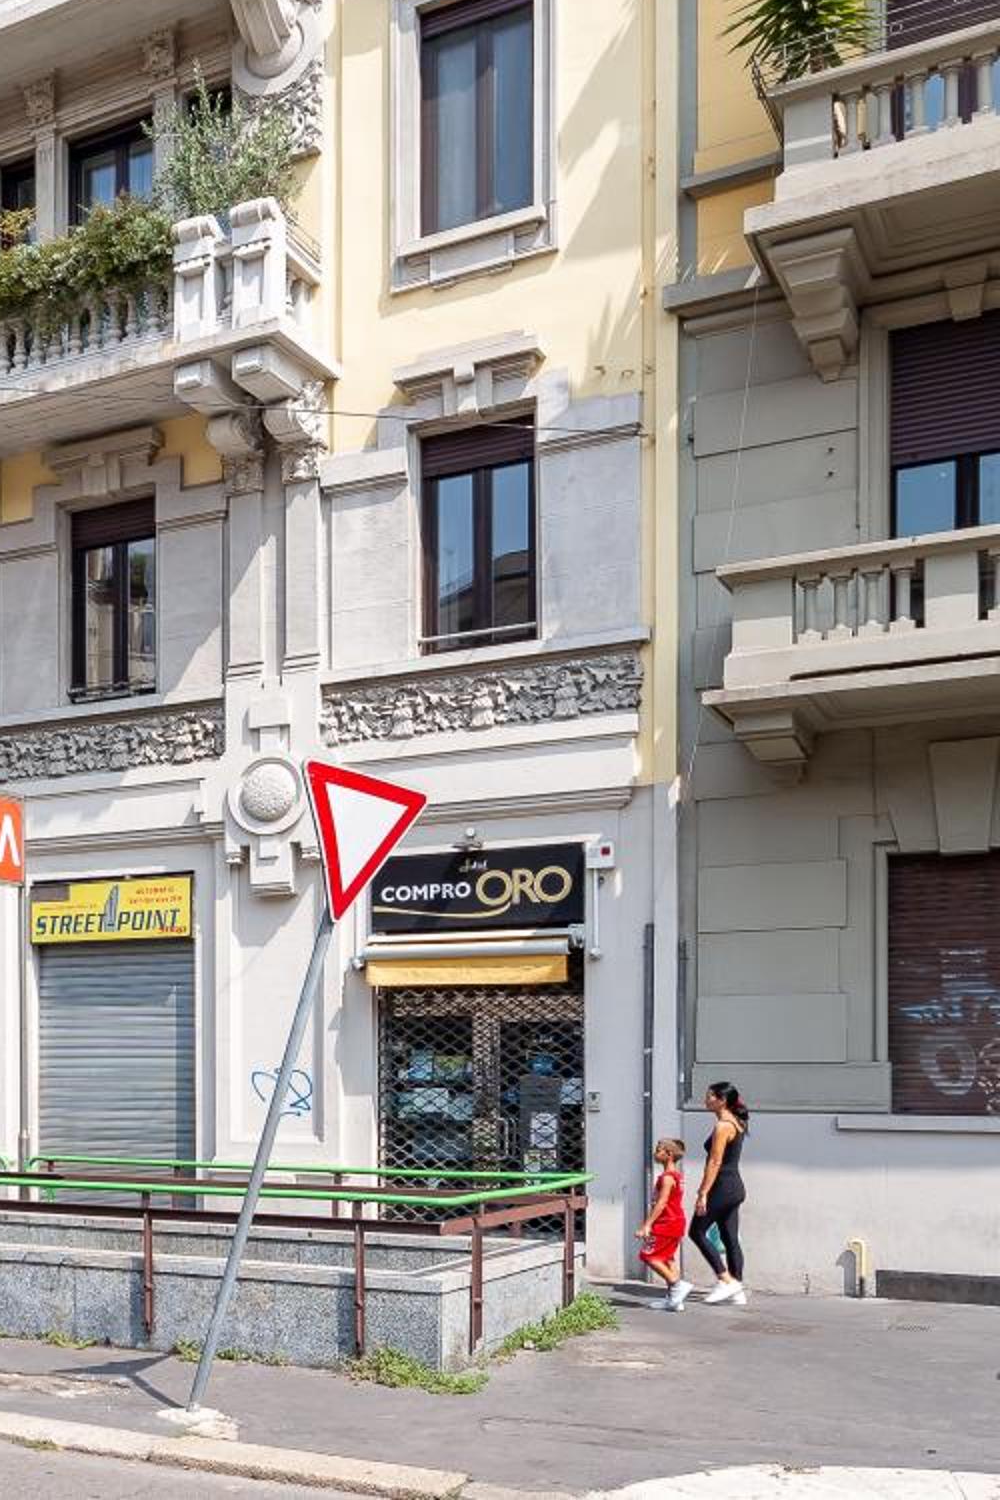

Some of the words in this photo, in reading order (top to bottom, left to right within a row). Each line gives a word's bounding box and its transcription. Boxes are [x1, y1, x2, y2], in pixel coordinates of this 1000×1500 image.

[380, 881, 471, 903] COMPRO
[476, 865, 573, 907] ORO
[35, 913, 106, 936] STREET
[116, 907, 181, 932] POINT
